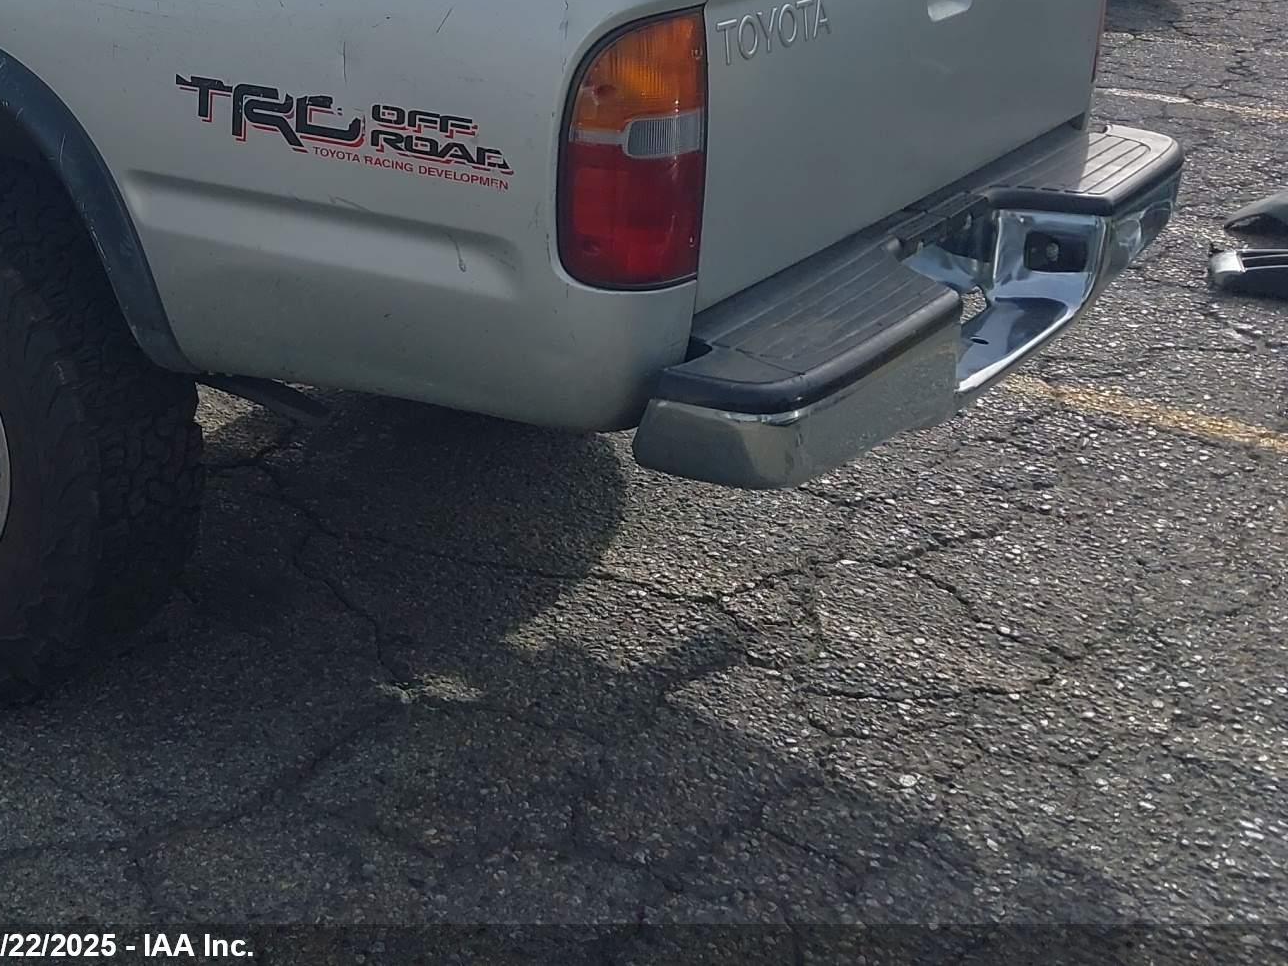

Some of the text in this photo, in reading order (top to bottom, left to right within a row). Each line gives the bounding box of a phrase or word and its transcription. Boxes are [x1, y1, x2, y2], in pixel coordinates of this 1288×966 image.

[371, 103, 479, 139] OFF
[313, 146, 361, 164] TOYOTA
[363, 155, 414, 173] RACING
